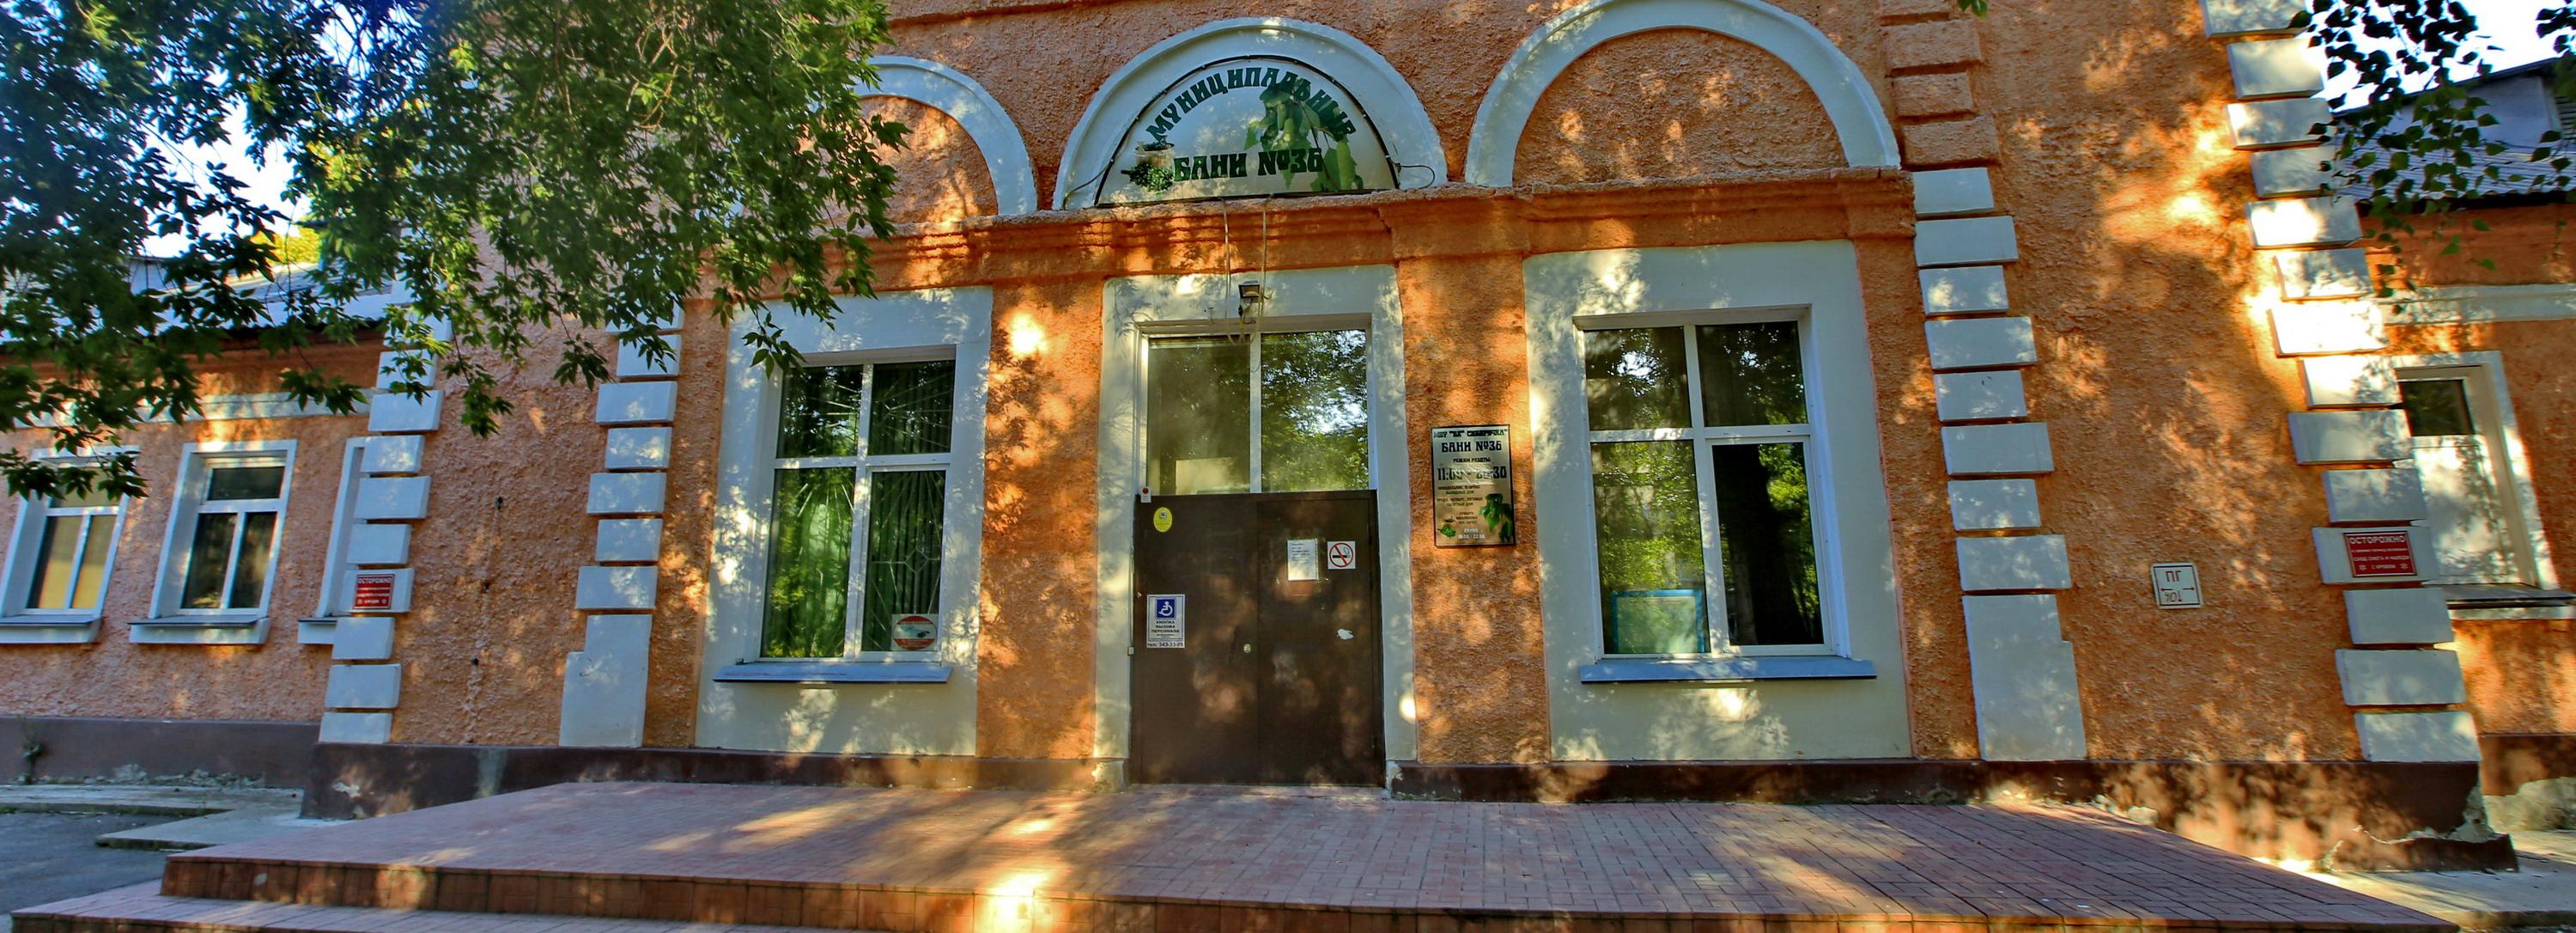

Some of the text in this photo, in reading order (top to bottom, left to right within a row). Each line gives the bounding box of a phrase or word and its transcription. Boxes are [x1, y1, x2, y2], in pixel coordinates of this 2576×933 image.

[1174, 148, 1325, 181] БАНИ №36
[1441, 440, 1502, 453] БАНИ №36
[2349, 535, 2405, 545] ОСТОРОЖНО
[2166, 570, 2184, 582] ПГ
